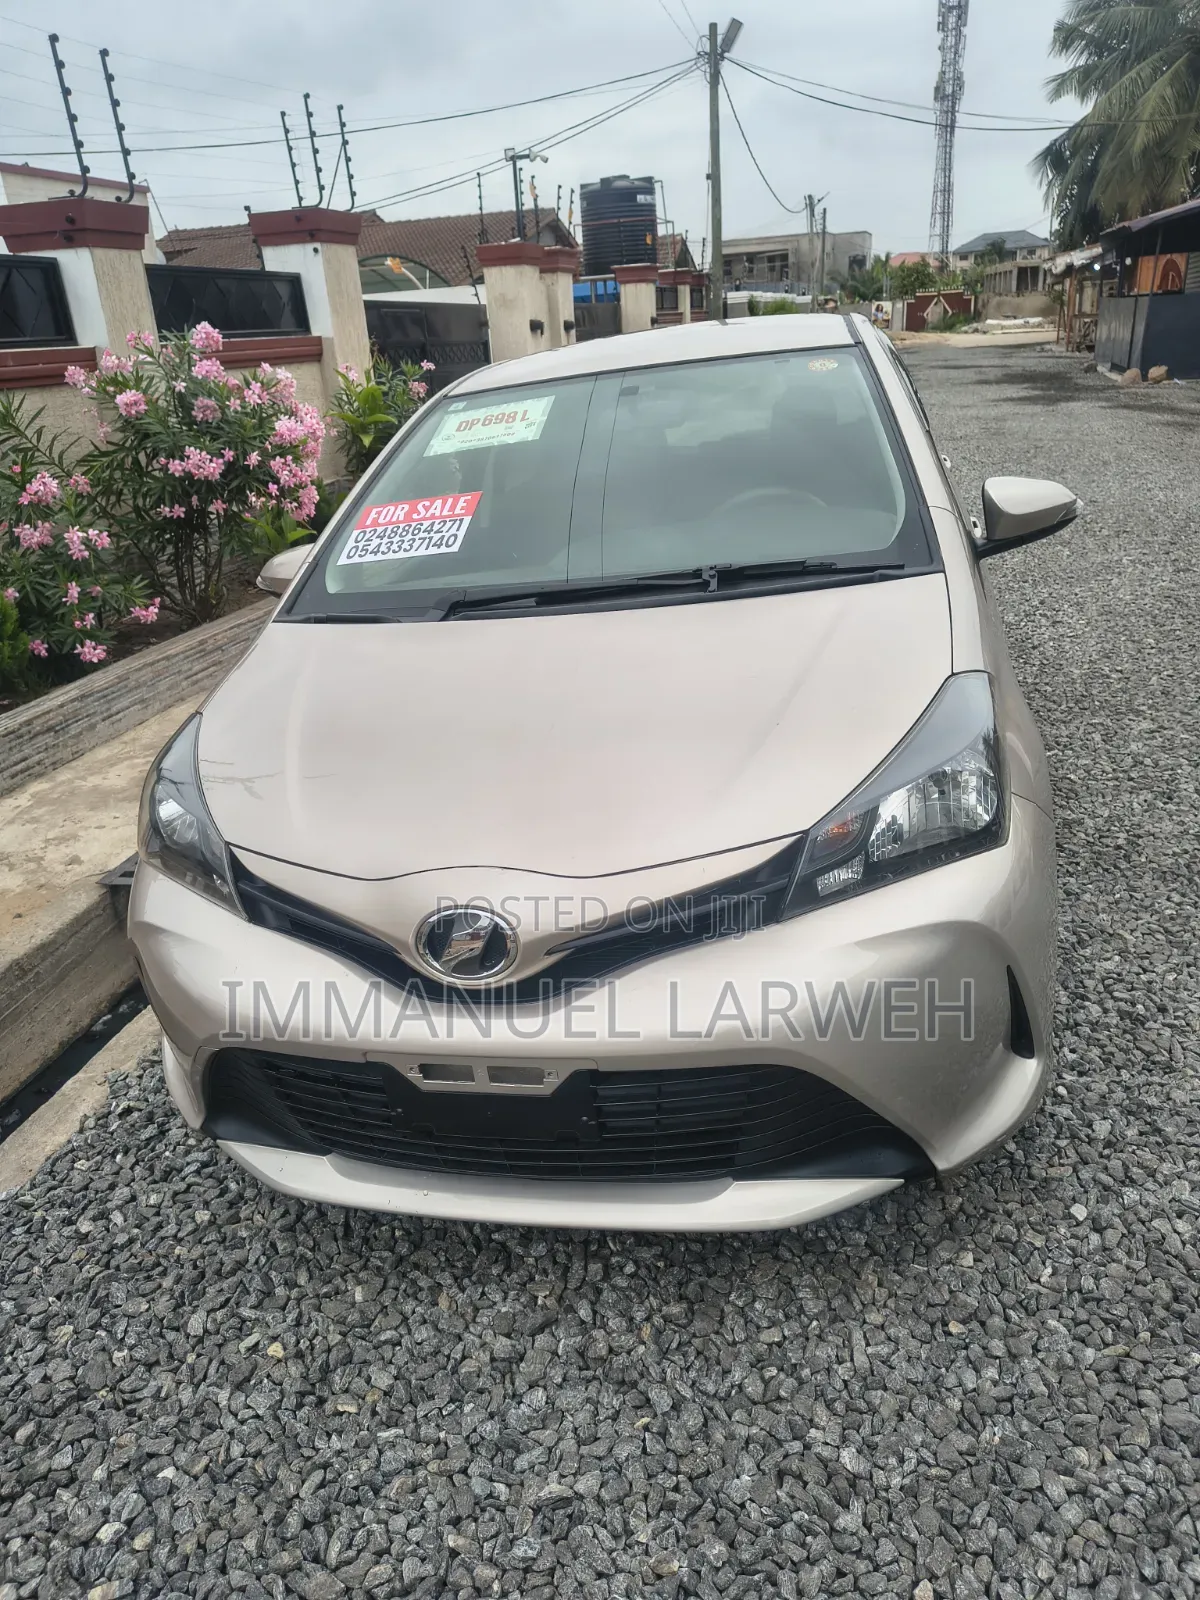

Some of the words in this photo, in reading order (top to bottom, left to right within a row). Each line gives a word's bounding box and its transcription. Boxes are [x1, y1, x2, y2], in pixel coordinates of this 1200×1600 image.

[481, 410, 518, 427] 698
[520, 409, 530, 422] L
[365, 504, 410, 526] FOR
[412, 496, 472, 519] SALE
[354, 518, 465, 544] 0248864271
[346, 533, 458, 560] 0543337140
